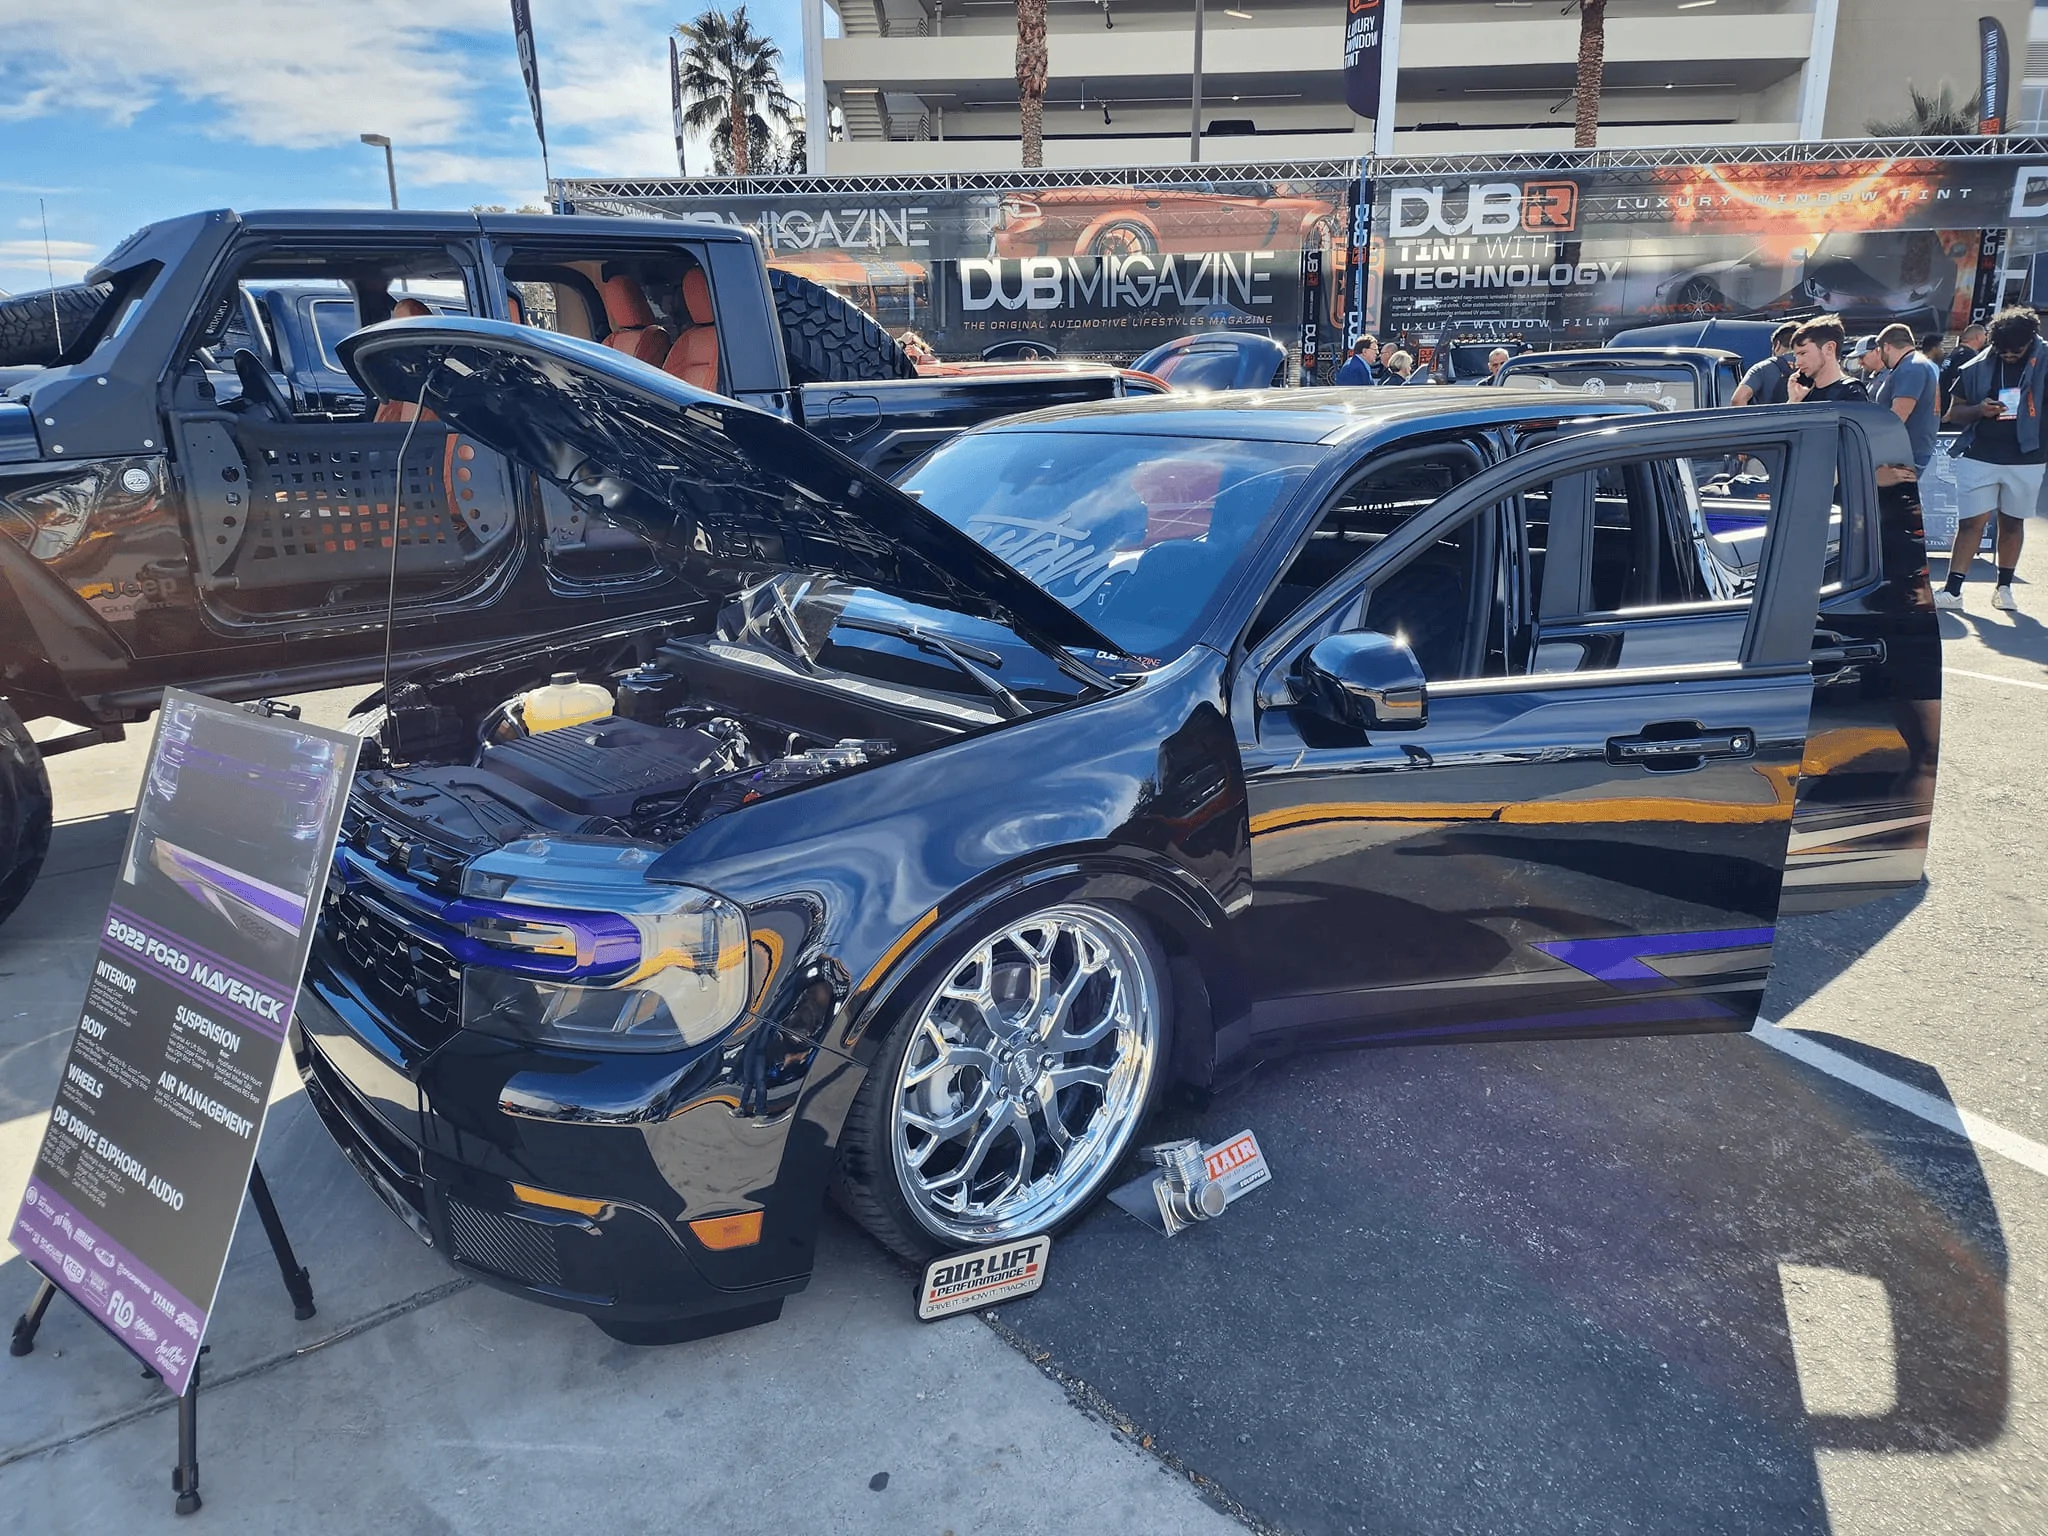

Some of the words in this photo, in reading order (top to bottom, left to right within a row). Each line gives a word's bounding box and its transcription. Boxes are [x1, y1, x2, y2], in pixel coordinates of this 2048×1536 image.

[1347, 15, 1375, 39] LUXURY
[1345, 30, 1378, 54] WINDOW
[1389, 183, 1521, 238] DUB
[1616, 196, 1731, 209] LUXURY
[1752, 190, 1879, 205] WINDOW
[1899, 187, 1974, 200] TINT
[1307, 250, 1318, 272] UB
[1395, 238, 1478, 262] TINT
[1484, 235, 1565, 259] WITH
[1393, 261, 1622, 290] TECHNOLOGY
[963, 321, 985, 330] THE
[990, 320, 1045, 330] ORIGINAL
[1050, 318, 1127, 329] AUTOMOTIVE
[1132, 316, 1205, 328] LIFESTYLES
[1208, 315, 1273, 326] MAGAZINE
[1562, 317, 1609, 327] FILM
[1304, 324, 1316, 355] DUB
[100, 576, 177, 600] Jeep
[96, 959, 137, 995] INTERIOR
[106, 917, 147, 953] 2022
[145, 937, 190, 975] FORD
[190, 961, 287, 1024] MAVERICK
[80, 1014, 107, 1041] BODY
[175, 1005, 241, 1053] SUSPENSION
[67, 1063, 104, 1099] WHEELS
[157, 1070, 177, 1093] AIR
[176, 1080, 254, 1140] MANAGEMENT
[53, 1105, 69, 1127] DB
[67, 1115, 98, 1150] DRIVE
[95, 1136, 147, 1187] EUPHORIA
[147, 1175, 184, 1212] AUDIO
[66, 1258, 82, 1279] KEG
[987, 1243, 1043, 1274] LIFT
[153, 1290, 177, 1316] VIAIR
[926, 1301, 952, 1314] DRIVE
[961, 1293, 986, 1305] SHOW
[1000, 1283, 1027, 1296] TRACK
